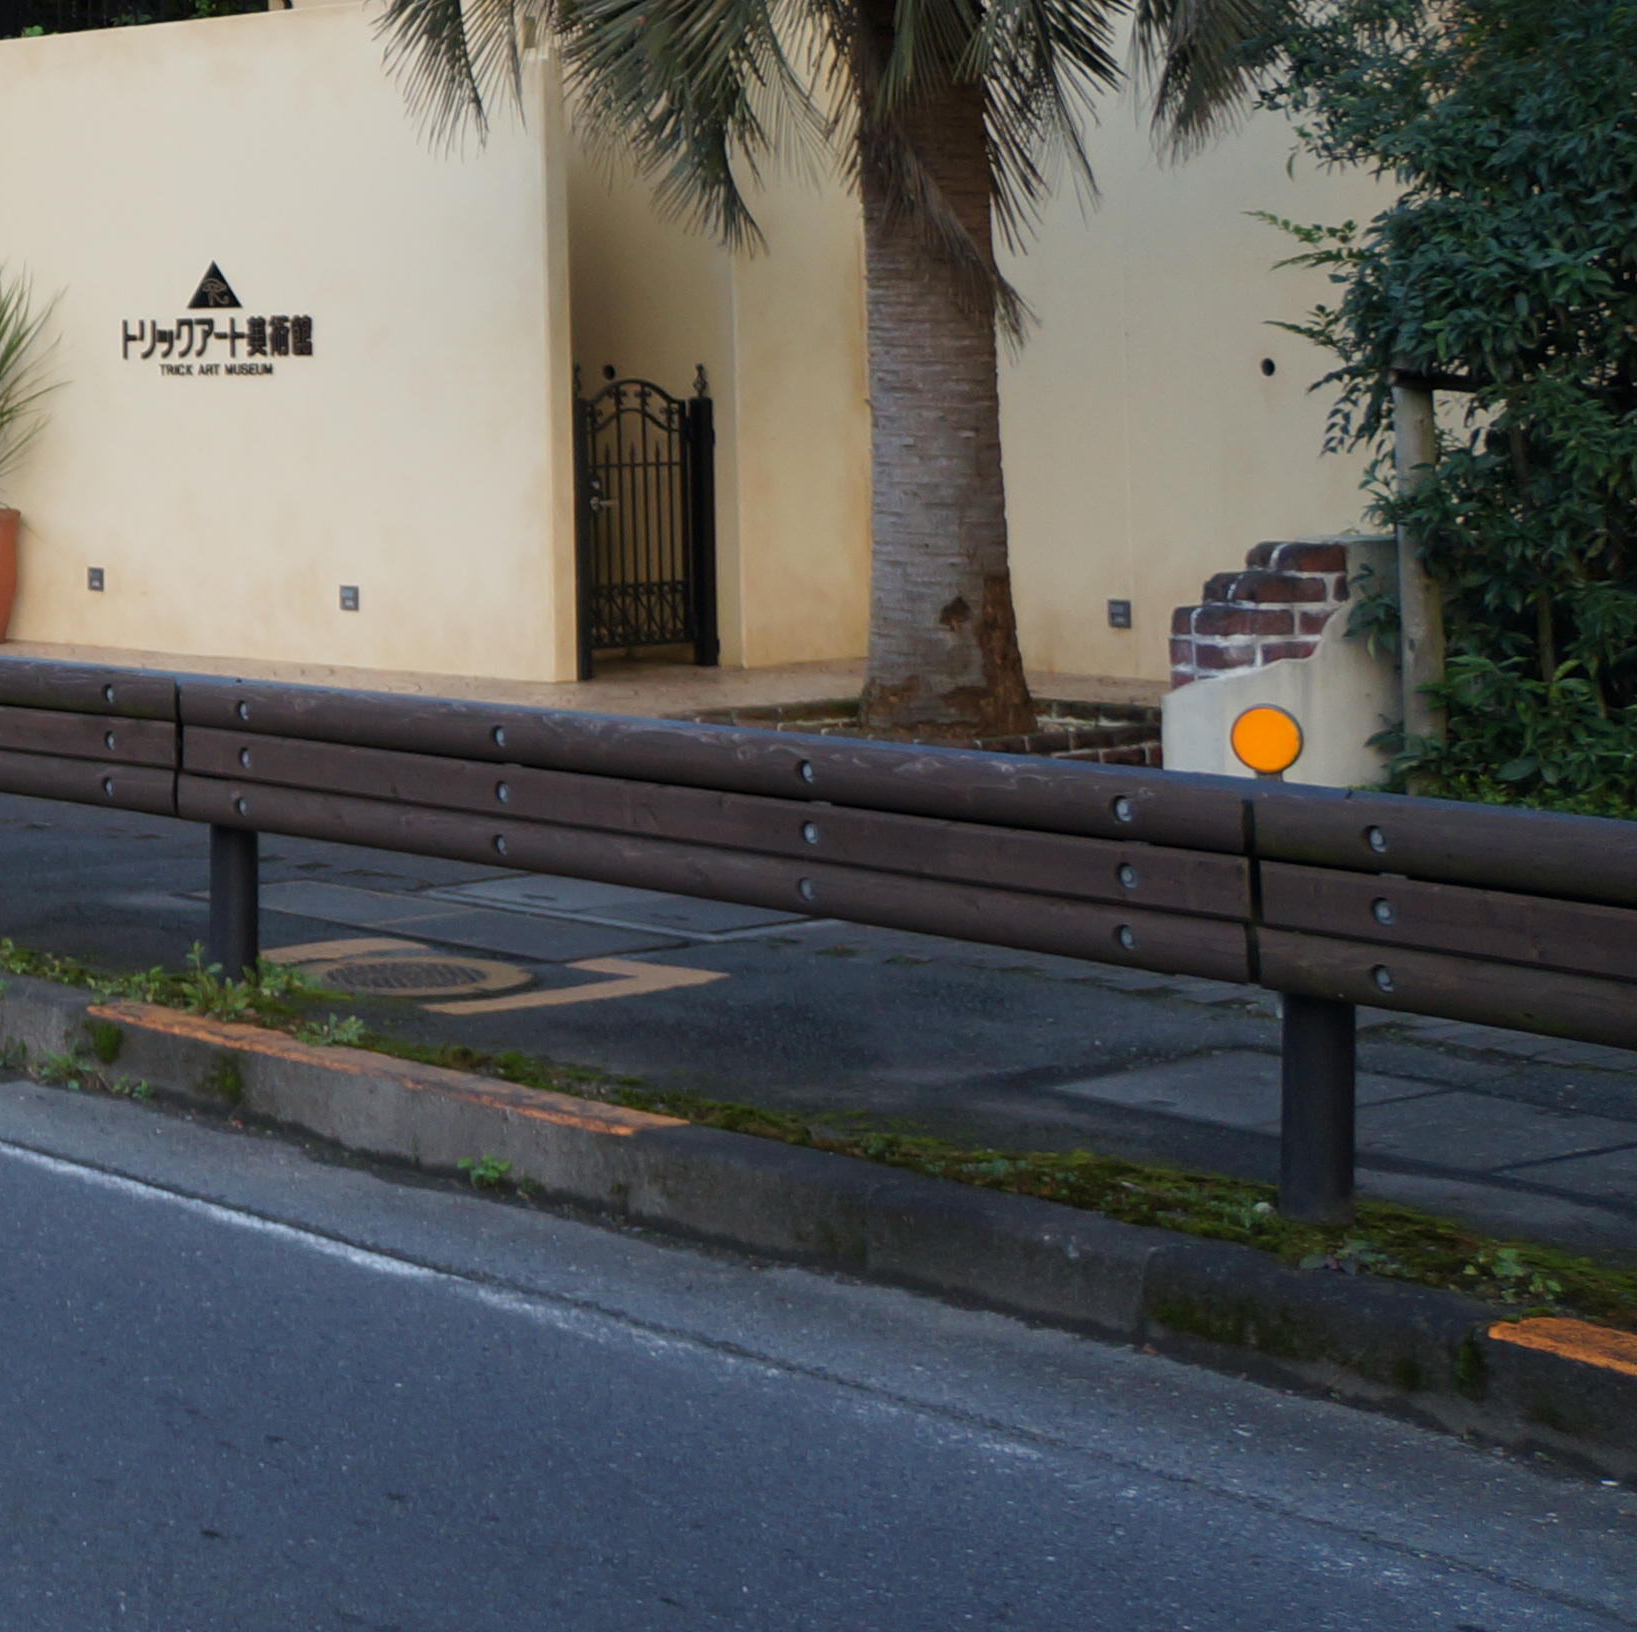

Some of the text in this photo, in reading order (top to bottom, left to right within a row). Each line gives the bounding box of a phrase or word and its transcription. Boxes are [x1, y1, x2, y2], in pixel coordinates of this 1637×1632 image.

[122, 315, 313, 360] トリックアート美術館
[159, 363, 274, 376] TRICK ART MUSEUM
